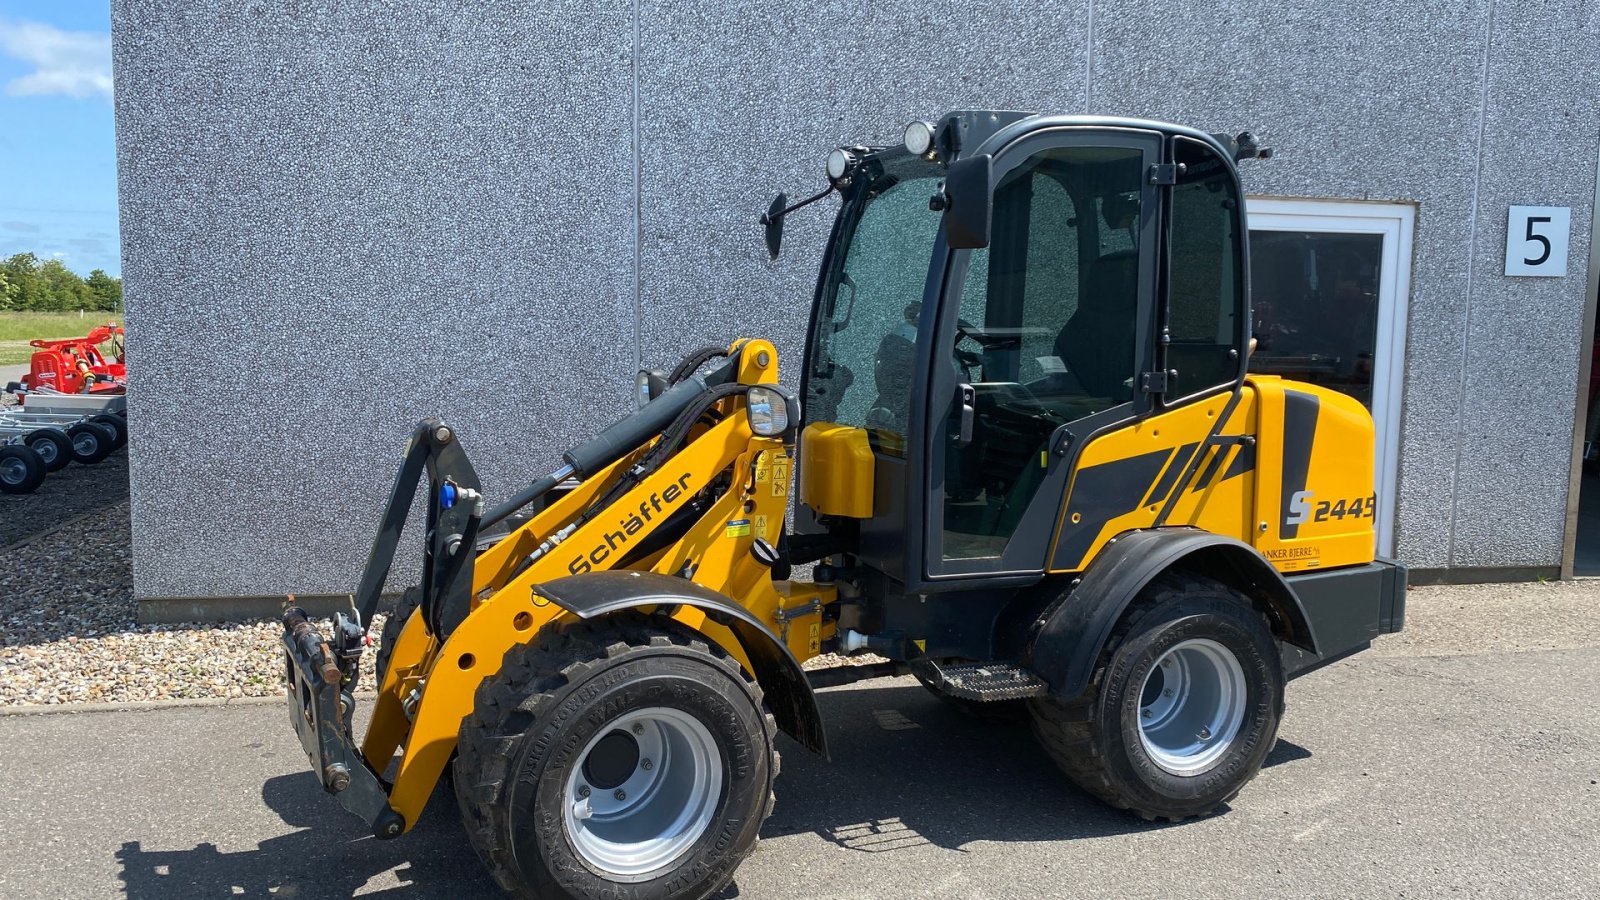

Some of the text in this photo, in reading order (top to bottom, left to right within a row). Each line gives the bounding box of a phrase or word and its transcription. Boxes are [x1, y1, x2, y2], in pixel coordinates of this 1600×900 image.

[1524, 216, 1551, 266] 5
[568, 472, 692, 576] Schäffer
[1286, 491, 1375, 525] S 2445
[1261, 549, 1288, 559] ANKER
[1289, 546, 1313, 558] BJERRE
[551, 684, 601, 730] POWER
